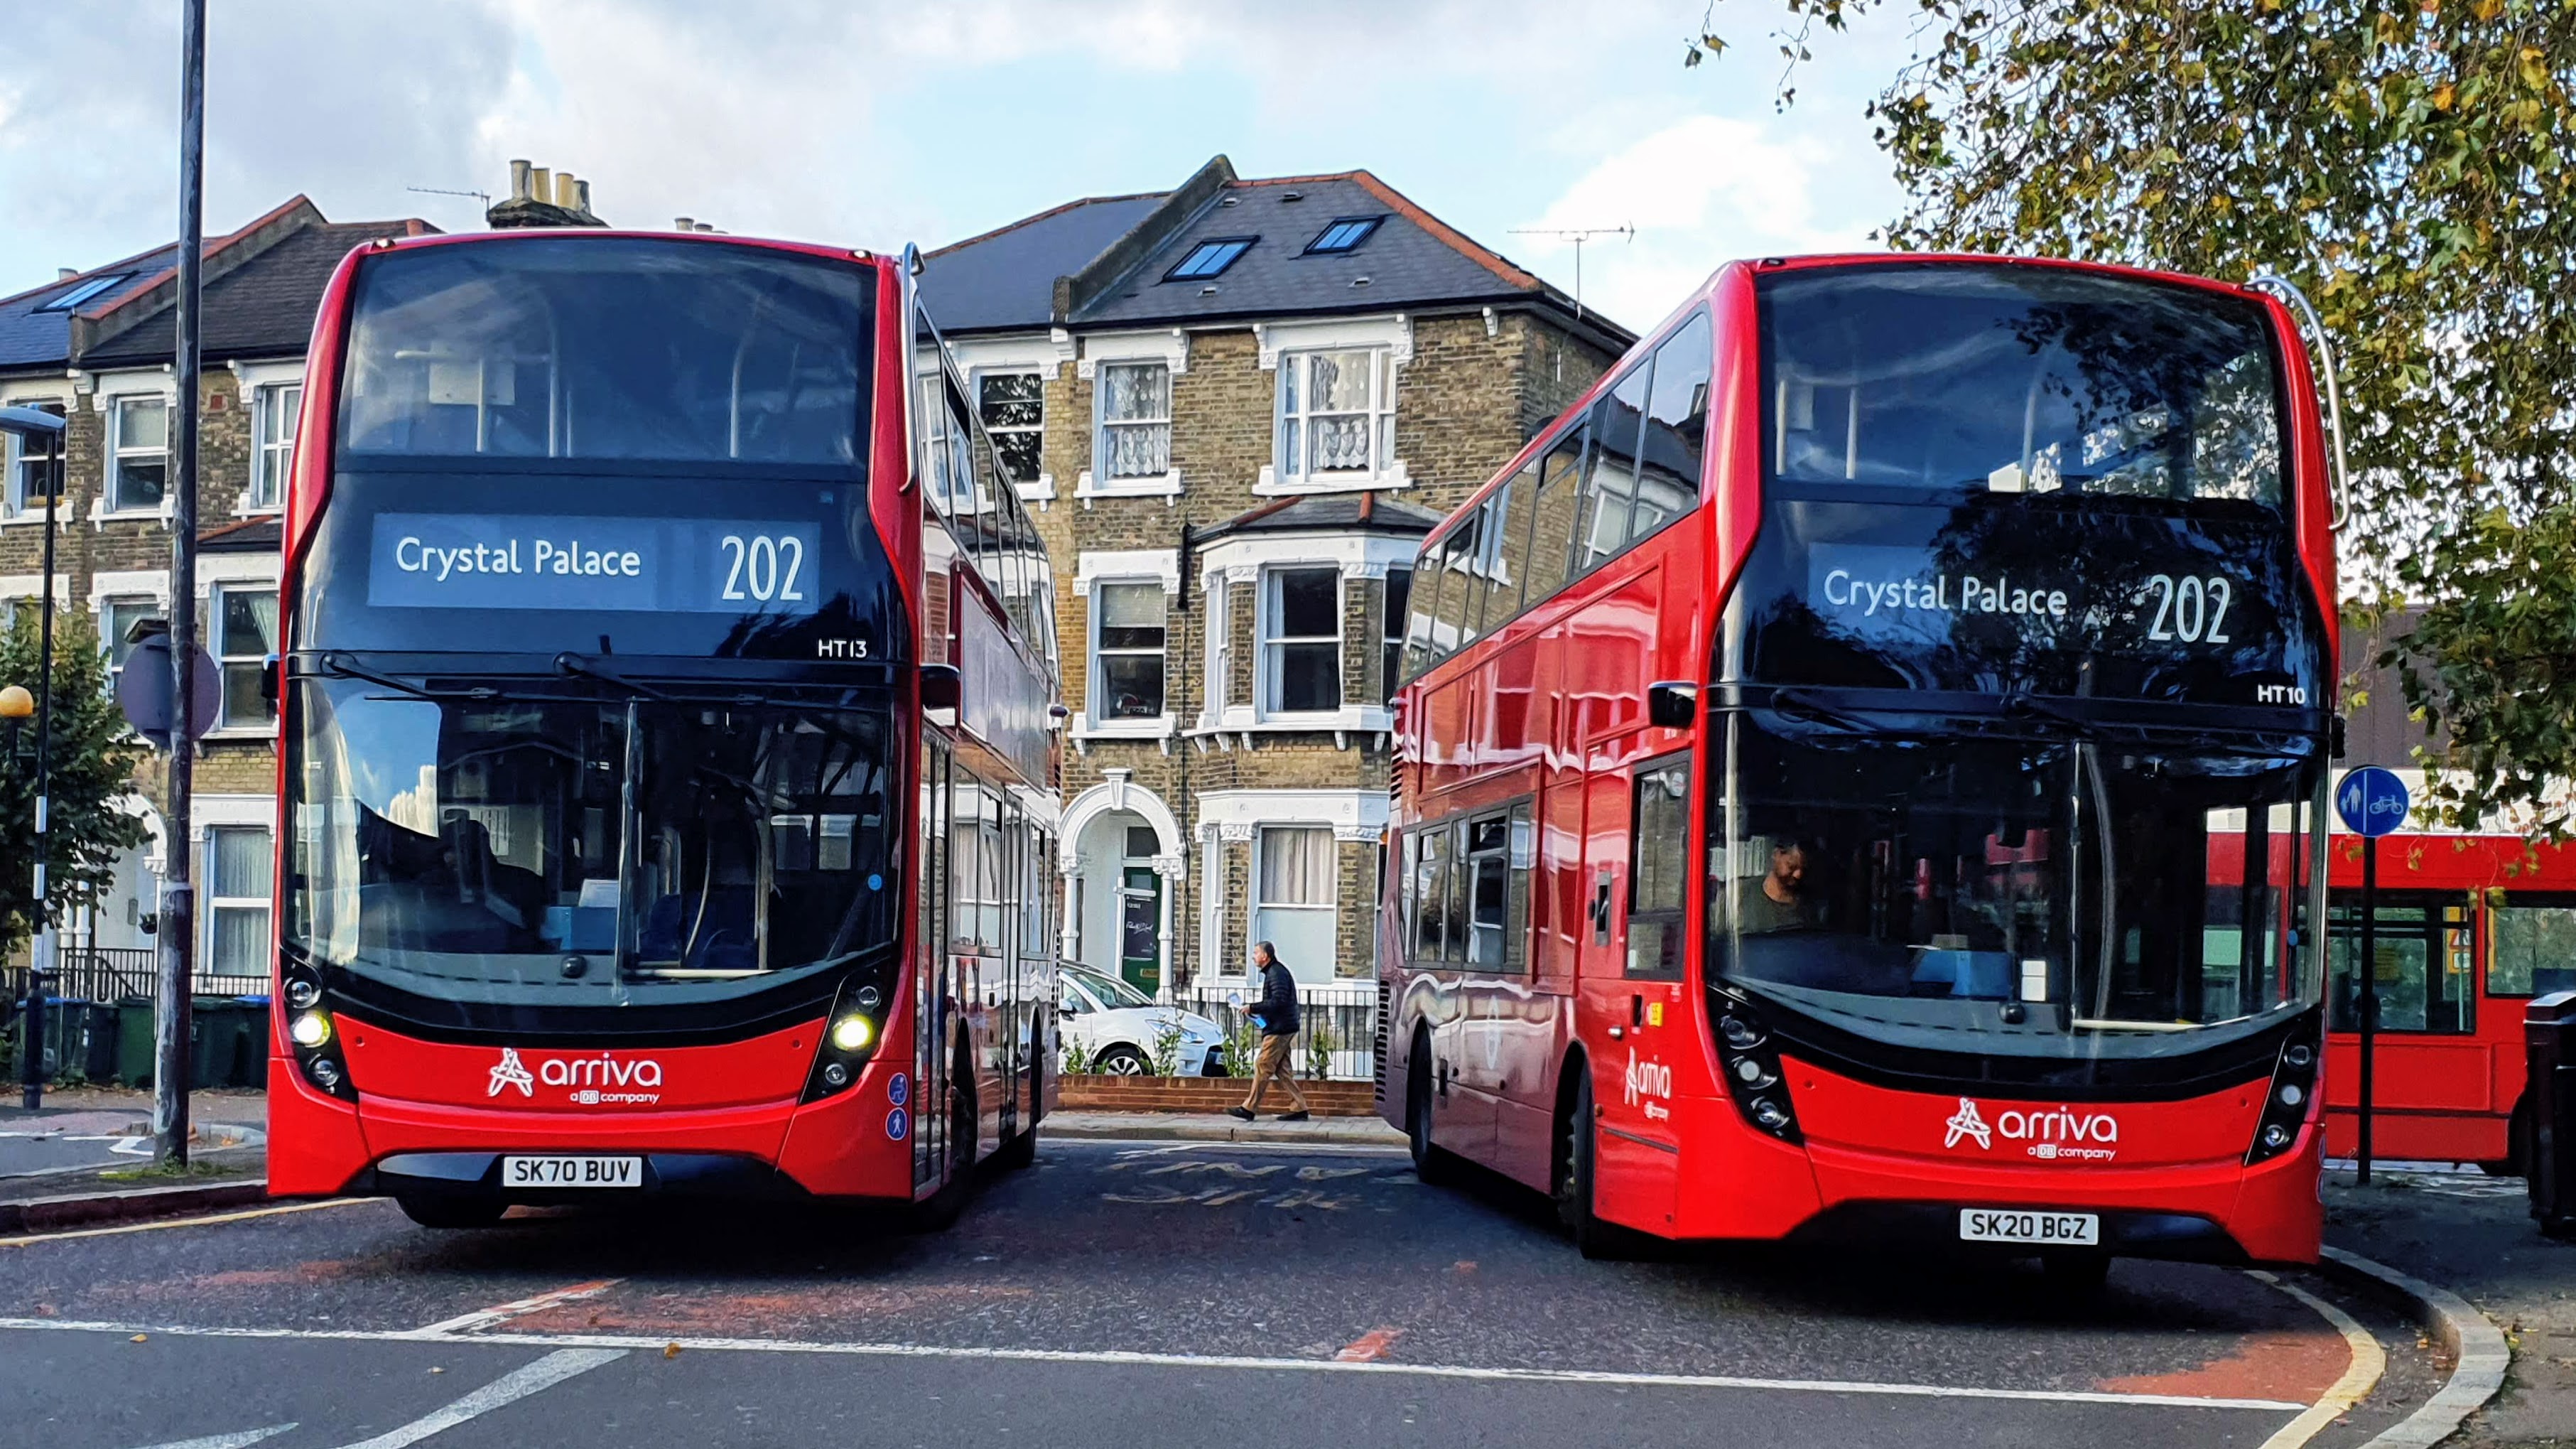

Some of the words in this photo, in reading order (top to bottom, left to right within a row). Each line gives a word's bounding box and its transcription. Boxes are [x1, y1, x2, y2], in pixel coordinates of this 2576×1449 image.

[396, 537, 523, 582] Crystal
[535, 539, 641, 577] Palace
[720, 535, 803, 601] 202
[1824, 570, 1949, 617] Crystal
[1962, 576, 2067, 617] Palace
[2148, 573, 2230, 644] 202
[2257, 684, 2306, 705] HT10
[541, 1052, 661, 1086] arriva
[1638, 1054, 1671, 1099] arriva
[570, 1093, 578, 1101] a
[579, 1090, 599, 1104] DB
[601, 1093, 660, 1104] company
[1998, 1105, 2118, 1143] arriva
[2028, 1147, 2036, 1156] a
[2037, 1144, 2057, 1159] DB
[2057, 1148, 2116, 1161] company
[514, 1160, 577, 1182] SK70
[585, 1160, 631, 1182] BUV
[1971, 1214, 2034, 1237] SK20
[2042, 1216, 2087, 1239] BGZ
